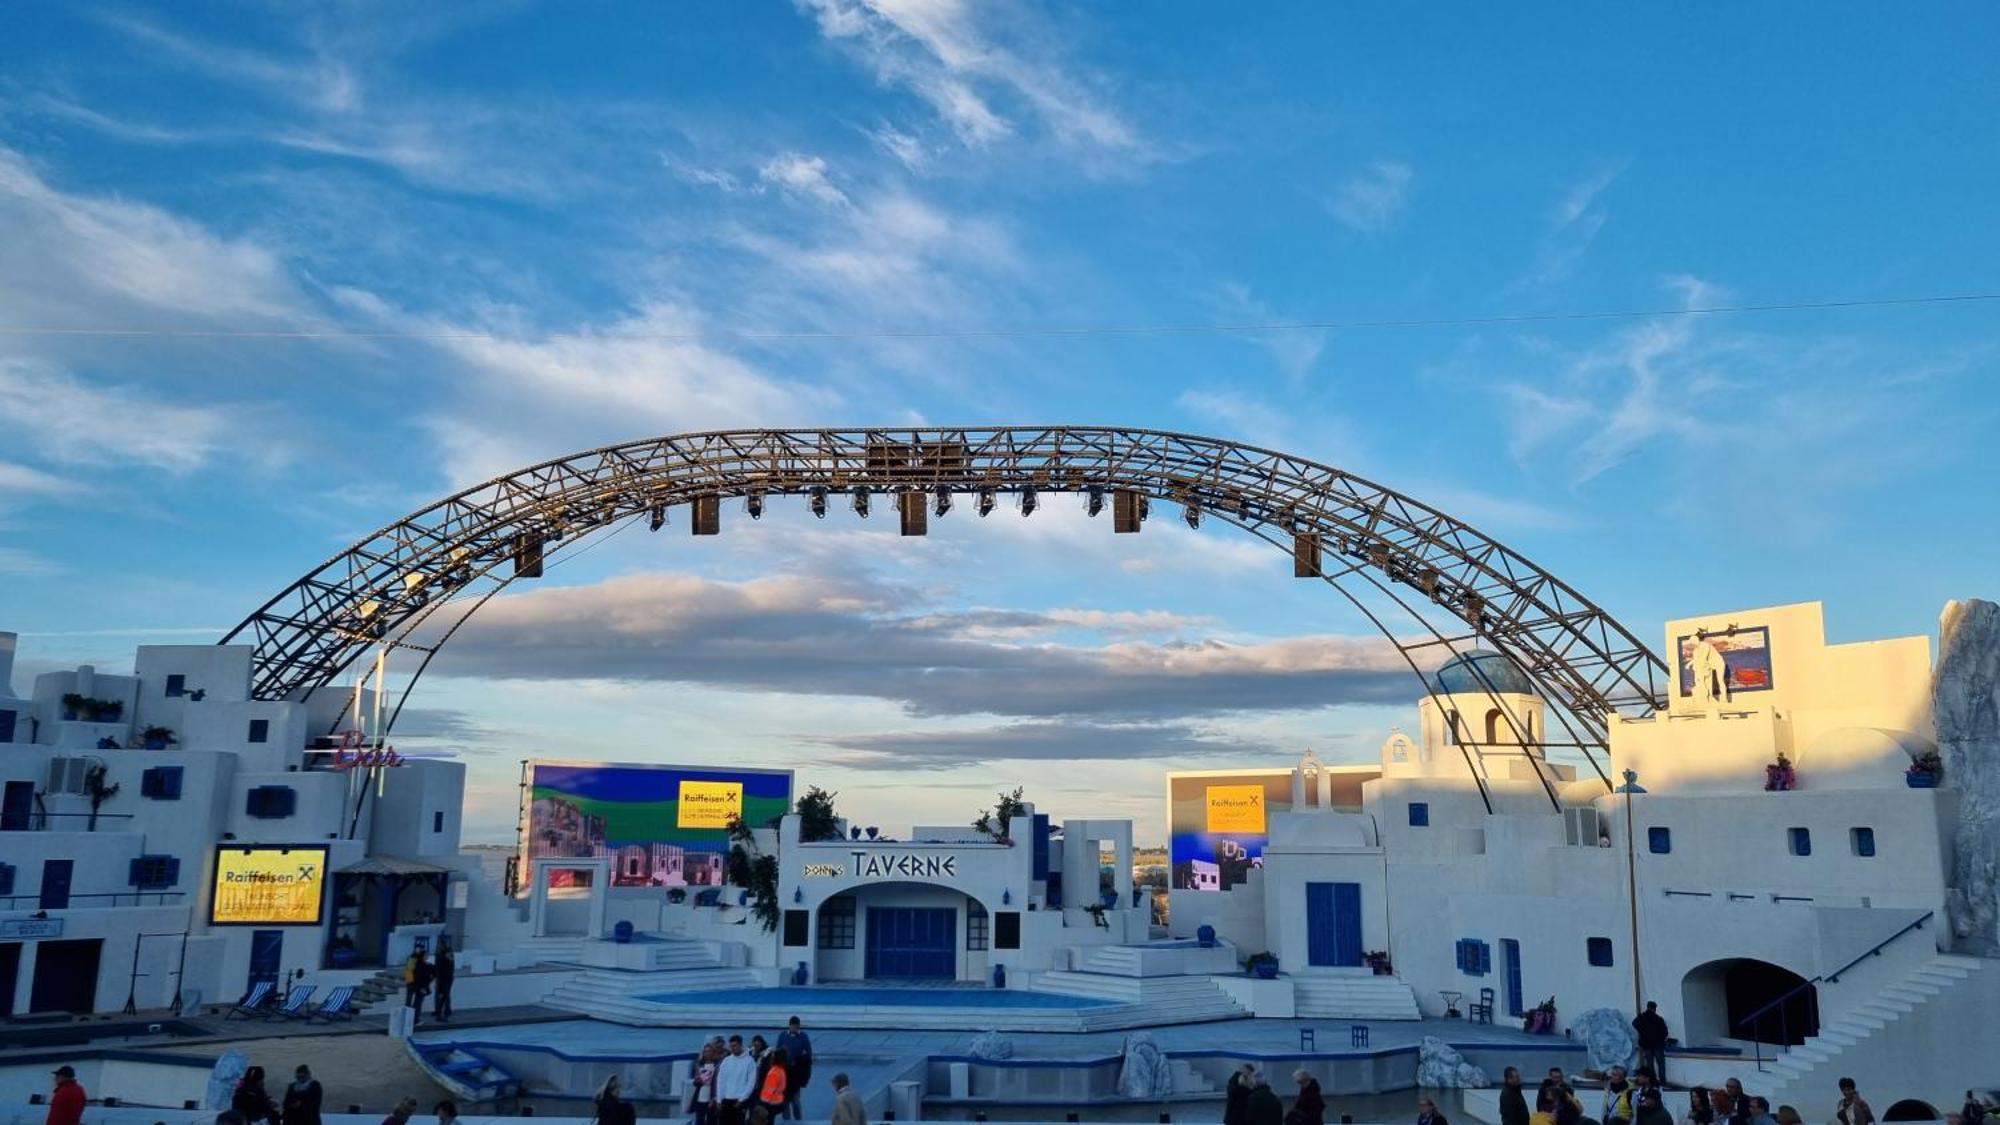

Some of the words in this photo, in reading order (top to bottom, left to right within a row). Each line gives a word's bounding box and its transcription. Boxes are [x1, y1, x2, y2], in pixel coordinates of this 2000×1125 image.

[336, 730, 405, 768] Bar
[684, 793, 725, 803] Raiffeisen
[804, 864, 844, 877] DONNS
[851, 852, 955, 876] TAVERNE
[226, 871, 294, 883] Raiffeisen
